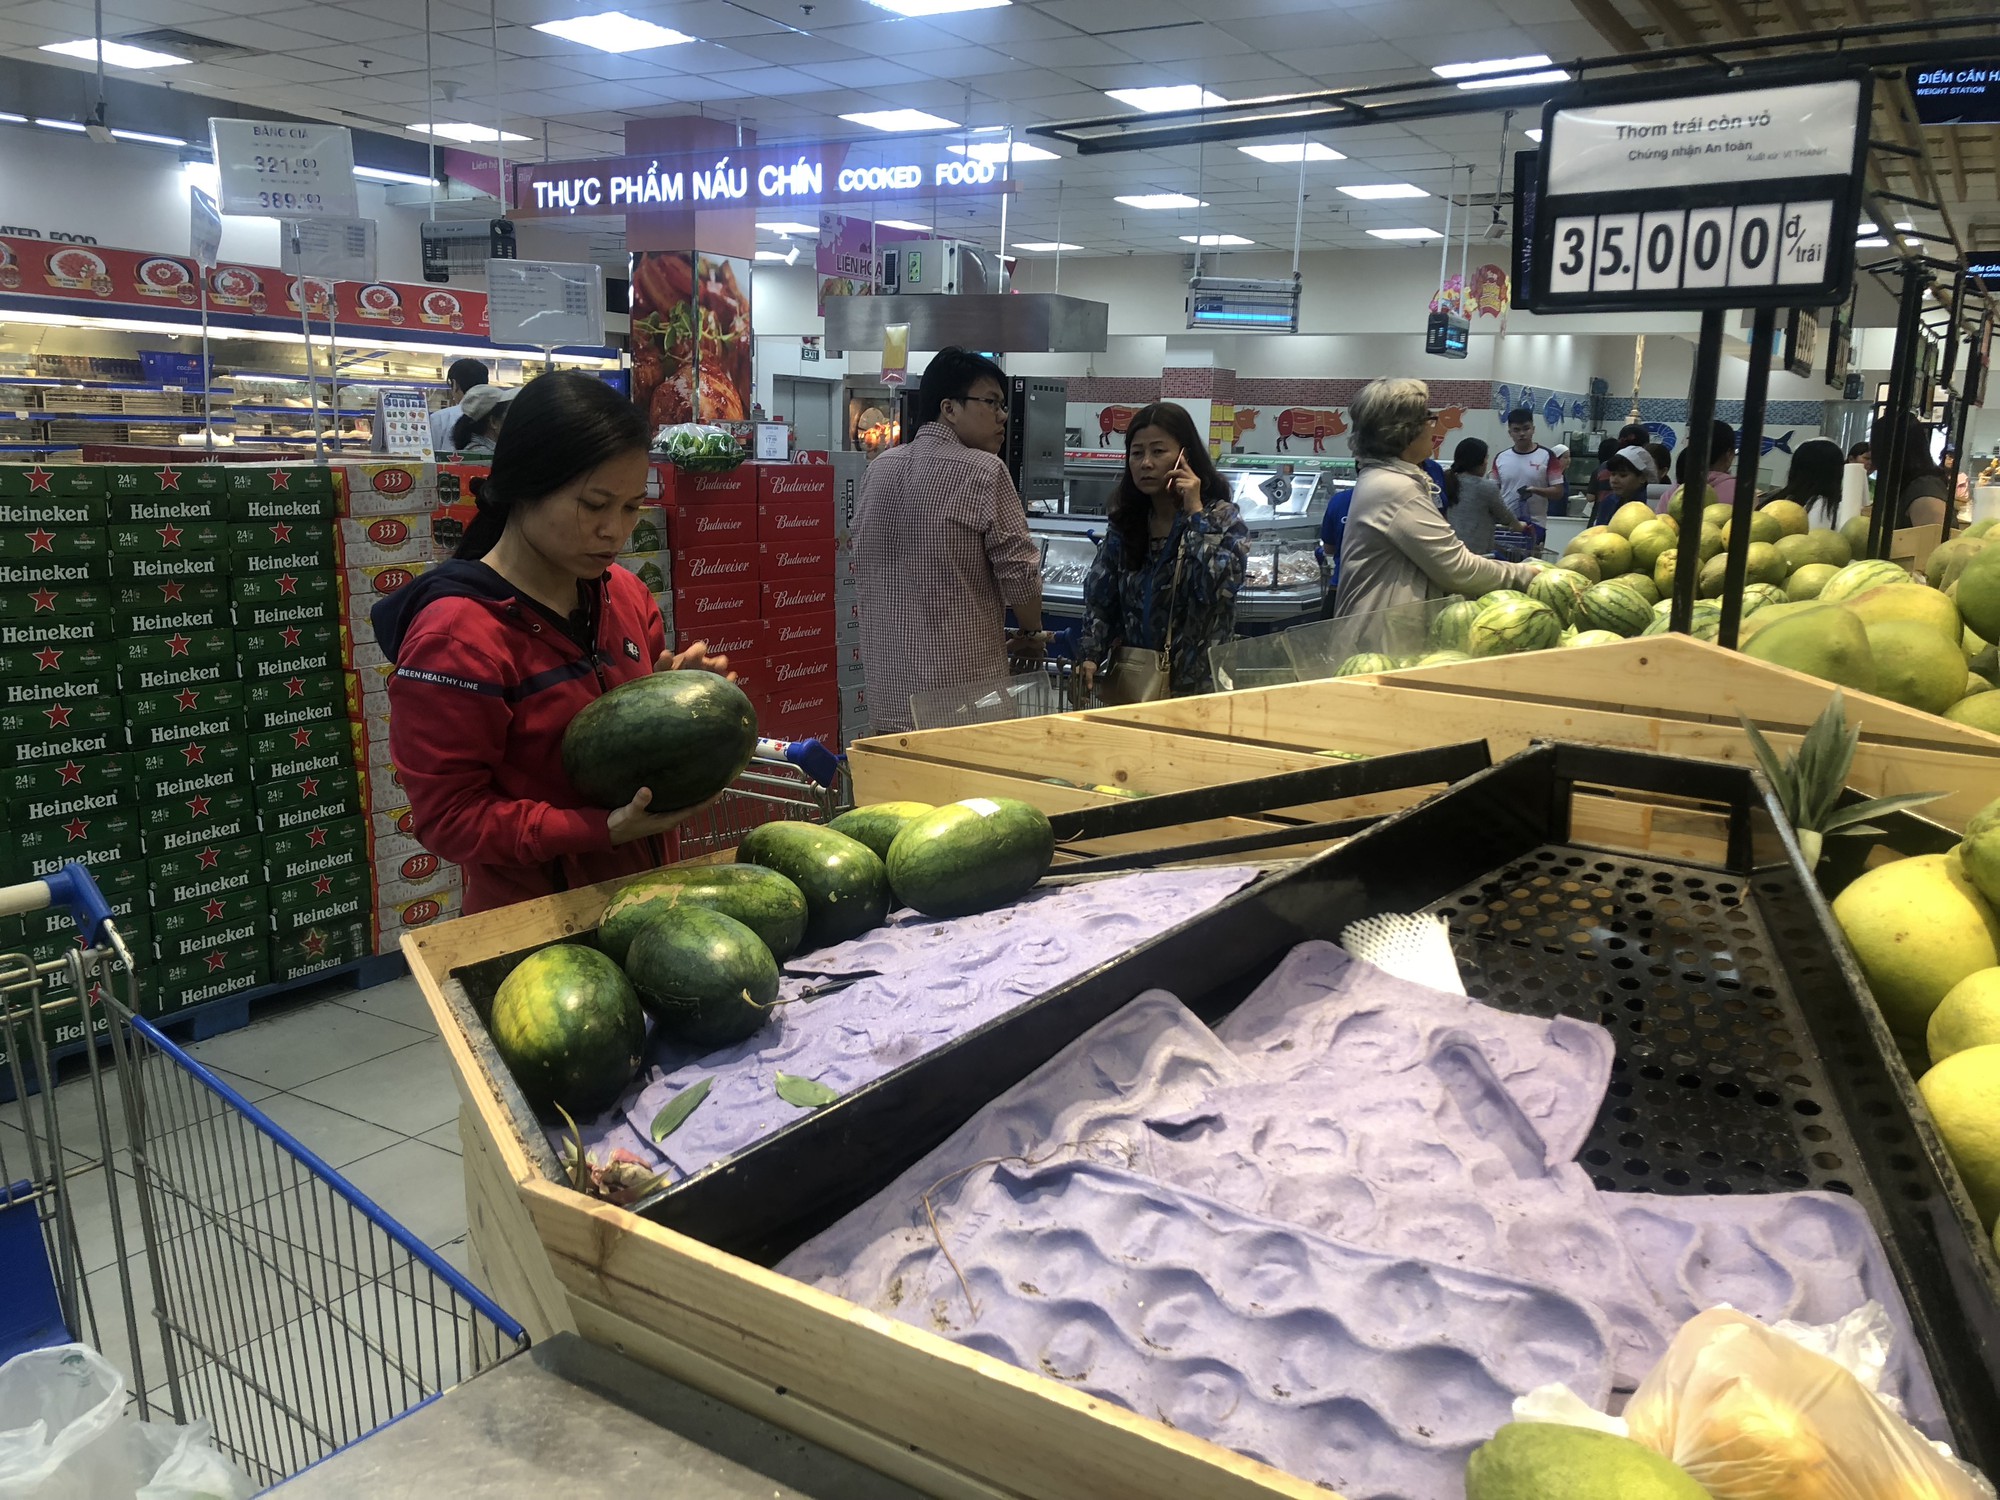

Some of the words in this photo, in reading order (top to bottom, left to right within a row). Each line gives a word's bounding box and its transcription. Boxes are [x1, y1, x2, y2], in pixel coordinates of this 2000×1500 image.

[1988, 70, 2000, 82] H
[1917, 87, 1948, 96] WEIGHT
[1950, 85, 1986, 95] STATION
[1615, 123, 1667, 141] Thơm
[1672, 116, 1702, 134] trái
[1708, 115, 1743, 132] còn
[1748, 108, 1772, 128] vỏ
[1705, 142, 1722, 154] An
[532, 177, 602, 214] THỰC
[609, 160, 684, 205] PHẨM
[692, 156, 748, 201] NẤU
[757, 156, 823, 198] CHÍN
[837, 165, 922, 193] COOKED
[935, 160, 996, 187] FOOD
[1559, 217, 1770, 276] 35.000
[836, 253, 859, 275] LIÊN
[804, 348, 819, 359] EXIT
[117, 474, 130, 484] 24
[234, 476, 245, 485] 24
[383, 473, 402, 487] 333
[694, 476, 742, 492] Budweiser
[770, 476, 825, 494] Budweiser
[0, 505, 90, 522] Heineken
[130, 502, 211, 520] Heineken
[248, 501, 321, 517] Heineken
[695, 516, 742, 532] Budweiser
[775, 514, 820, 529] Budweiser
[119, 532, 131, 542] 24
[237, 530, 248, 539] 24
[378, 524, 397, 539] 333
[634, 534, 658, 549] SAIGON
[133, 559, 215, 576] Heineken
[248, 554, 319, 571] Heineken
[689, 557, 750, 577] Budweiser
[776, 552, 821, 567] Budweiser
[0, 564, 90, 582] Heineken
[384, 572, 403, 587] 333
[121, 589, 133, 599] 24
[243, 583, 254, 592] 24
[695, 597, 744, 613] Budweiser
[773, 590, 826, 609] Budweiser
[132, 612, 213, 631] Heineken
[254, 606, 323, 624] Heineken
[2, 624, 95, 643] Heineken
[248, 637, 259, 646] 24
[778, 626, 822, 641] Budweiser
[129, 645, 140, 655] 24
[258, 656, 327, 677] Heineken
[775, 661, 828, 682] Budweiser
[140, 667, 220, 688] Heineken
[421, 672, 458, 686] HEALTHY
[459, 681, 479, 690] LINE
[8, 682, 99, 702] Heineken
[252, 688, 263, 697] 24
[137, 701, 149, 711] 24
[779, 697, 824, 714] Budweiser
[2, 716, 16, 726] 24
[264, 706, 332, 728] Heineken
[151, 721, 230, 743] Heineken
[16, 737, 107, 760] Heineken
[259, 740, 269, 749] 24
[145, 756, 157, 766] 24
[271, 755, 339, 778] Heineken
[15, 775, 28, 785] 24
[156, 772, 234, 797] Heineken
[267, 790, 278, 800] 24
[29, 793, 118, 820] Heineken
[151, 810, 163, 819] 24
[278, 803, 345, 828] Heineken
[21, 833, 34, 843] 24
[164, 822, 240, 850] Heineken
[275, 841, 286, 851] 24
[161, 863, 172, 873] 24
[286, 852, 353, 878] Heineken
[411, 857, 429, 873] 333
[174, 874, 249, 902] Heineken
[281, 890, 292, 900] 24
[293, 900, 358, 928] Heineken
[412, 904, 430, 920] 333
[166, 916, 178, 926] 24
[179, 925, 255, 955] Heineken
[33, 947, 46, 957] 24
[169, 967, 180, 977] 24
[288, 957, 342, 980] Heineken
[181, 974, 256, 1006] Heineken
